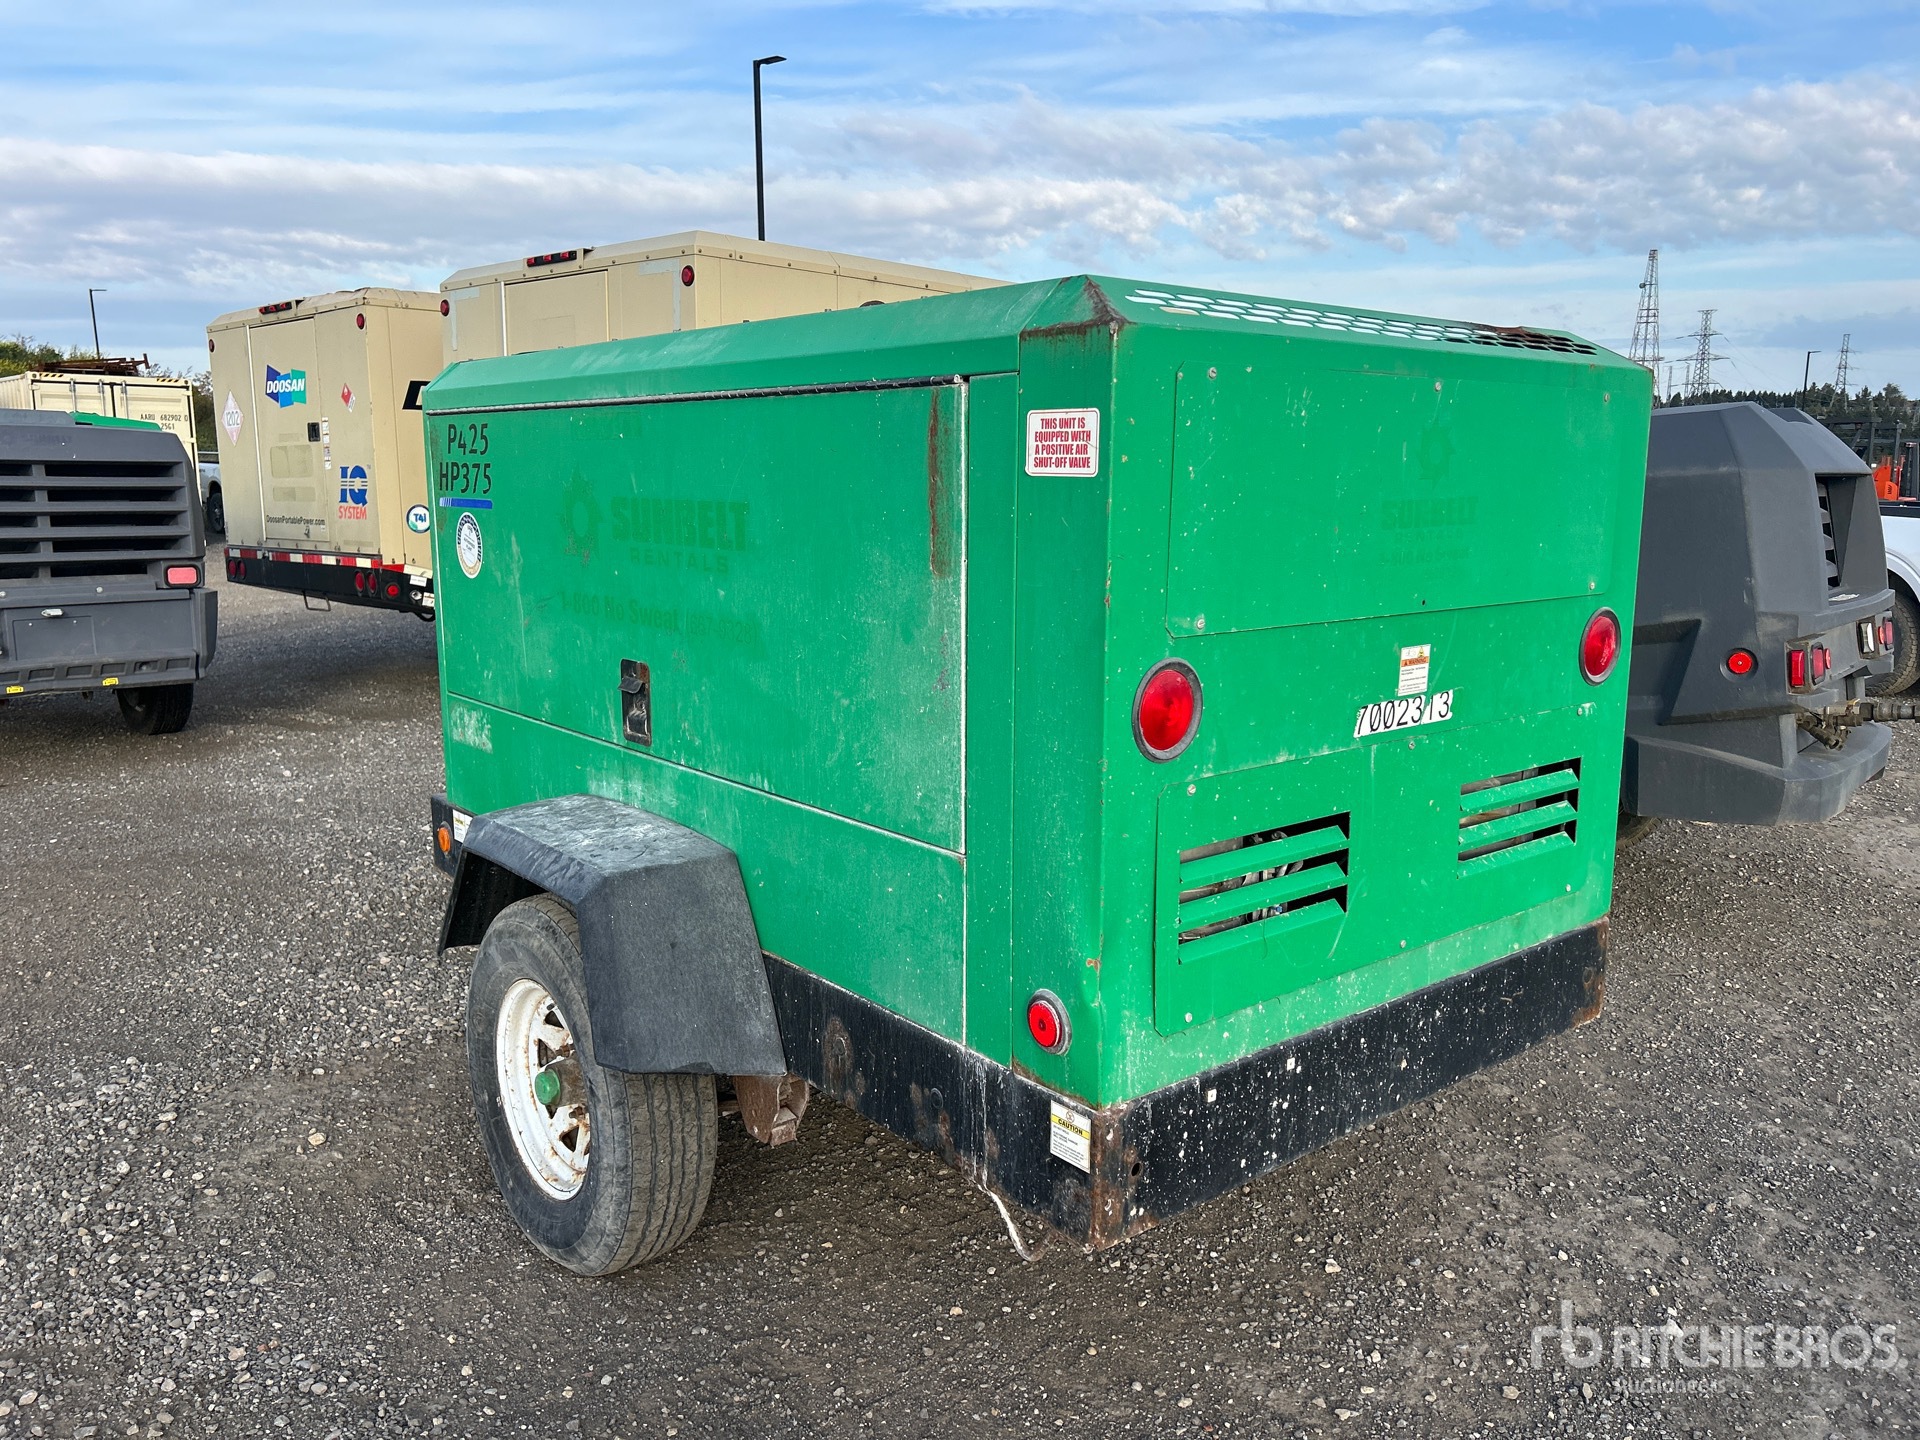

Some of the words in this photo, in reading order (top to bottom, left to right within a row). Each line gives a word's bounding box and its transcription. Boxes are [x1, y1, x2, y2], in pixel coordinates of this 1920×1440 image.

[266, 378, 305, 394] DOOSAN
[160, 414, 182, 422] 682902
[225, 411, 240, 426] 1202
[1040, 417, 1057, 430] THIS
[1059, 417, 1077, 430] UNIT
[1078, 416, 1086, 429] IS
[161, 422, 175, 430] 25G1
[447, 423, 489, 455] P425
[1034, 430, 1069, 443] EQUIPPED
[1071, 430, 1091, 442] WITH
[1034, 444, 1040, 455] A
[1041, 443, 1074, 455] POSITIVE
[1075, 443, 1089, 455] AIR
[1033, 456, 1067, 469] SHUT-OFF
[1068, 456, 1091, 469] VALVE
[439, 461, 492, 494] HP375
[339, 465, 368, 507] IQ
[266, 514, 326, 526] DoosanPortablePower.com
[338, 505, 367, 520] SYSTEM
[610, 495, 750, 552] SUNBELT
[629, 547, 730, 575] RENTALS
[1357, 691, 1450, 735] 7002313
[1058, 1118, 1083, 1136] CAUTION
